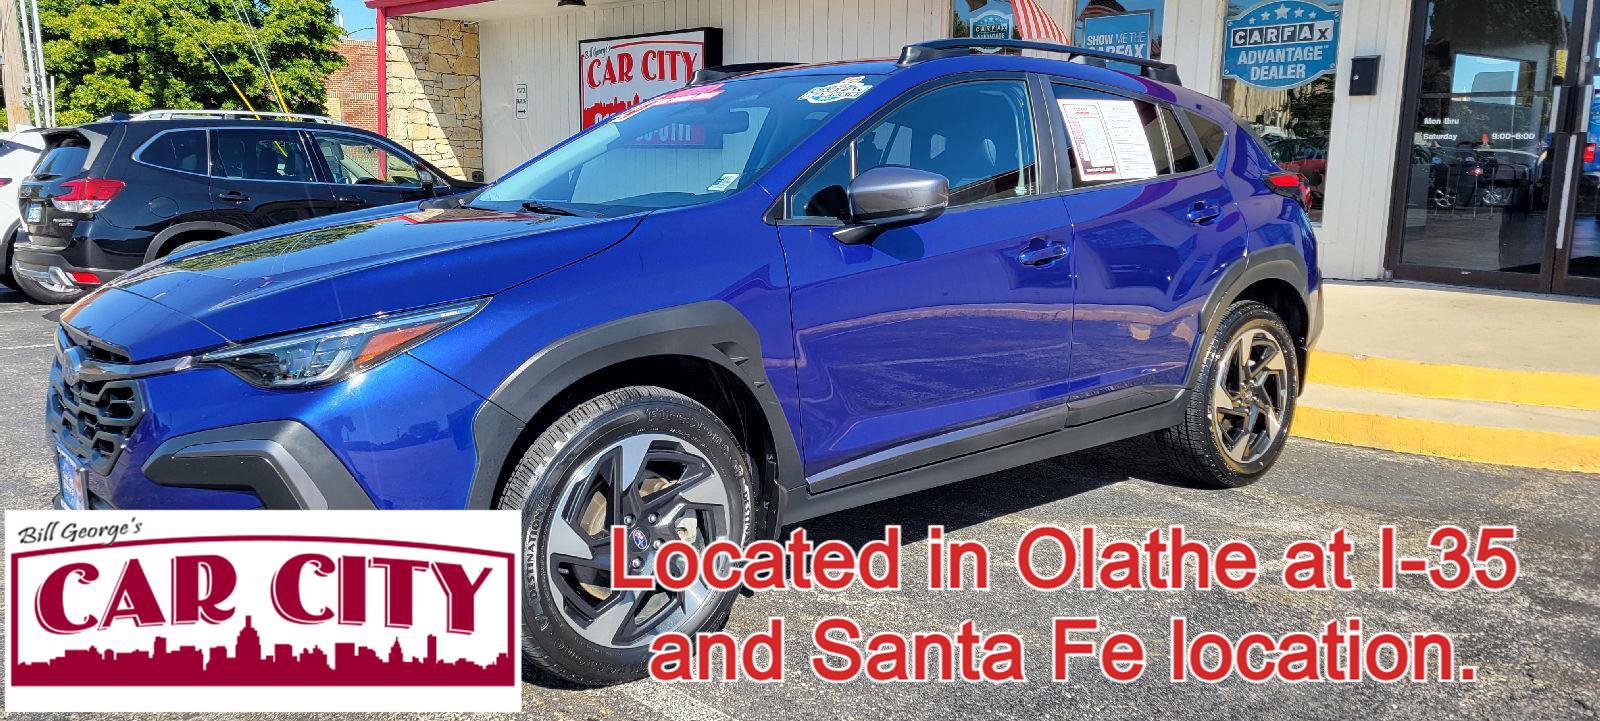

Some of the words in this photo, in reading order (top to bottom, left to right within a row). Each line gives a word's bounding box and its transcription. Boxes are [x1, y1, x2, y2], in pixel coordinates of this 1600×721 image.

[1086, 34, 1114, 46] SHOW
[1115, 33, 1128, 44] ME
[1129, 31, 1147, 43] THE
[1234, 25, 1331, 46] CARFAX
[1237, 46, 1323, 65] ADVANTAGE
[587, 52, 634, 90] CAR
[640, 49, 698, 84] CITY
[1250, 64, 1306, 81] DEALER
[1423, 117, 1441, 125] Mon
[1442, 117, 1460, 125] thru
[1423, 133, 1458, 141] Saturday
[526, 509, 544, 600] DESTINATION
